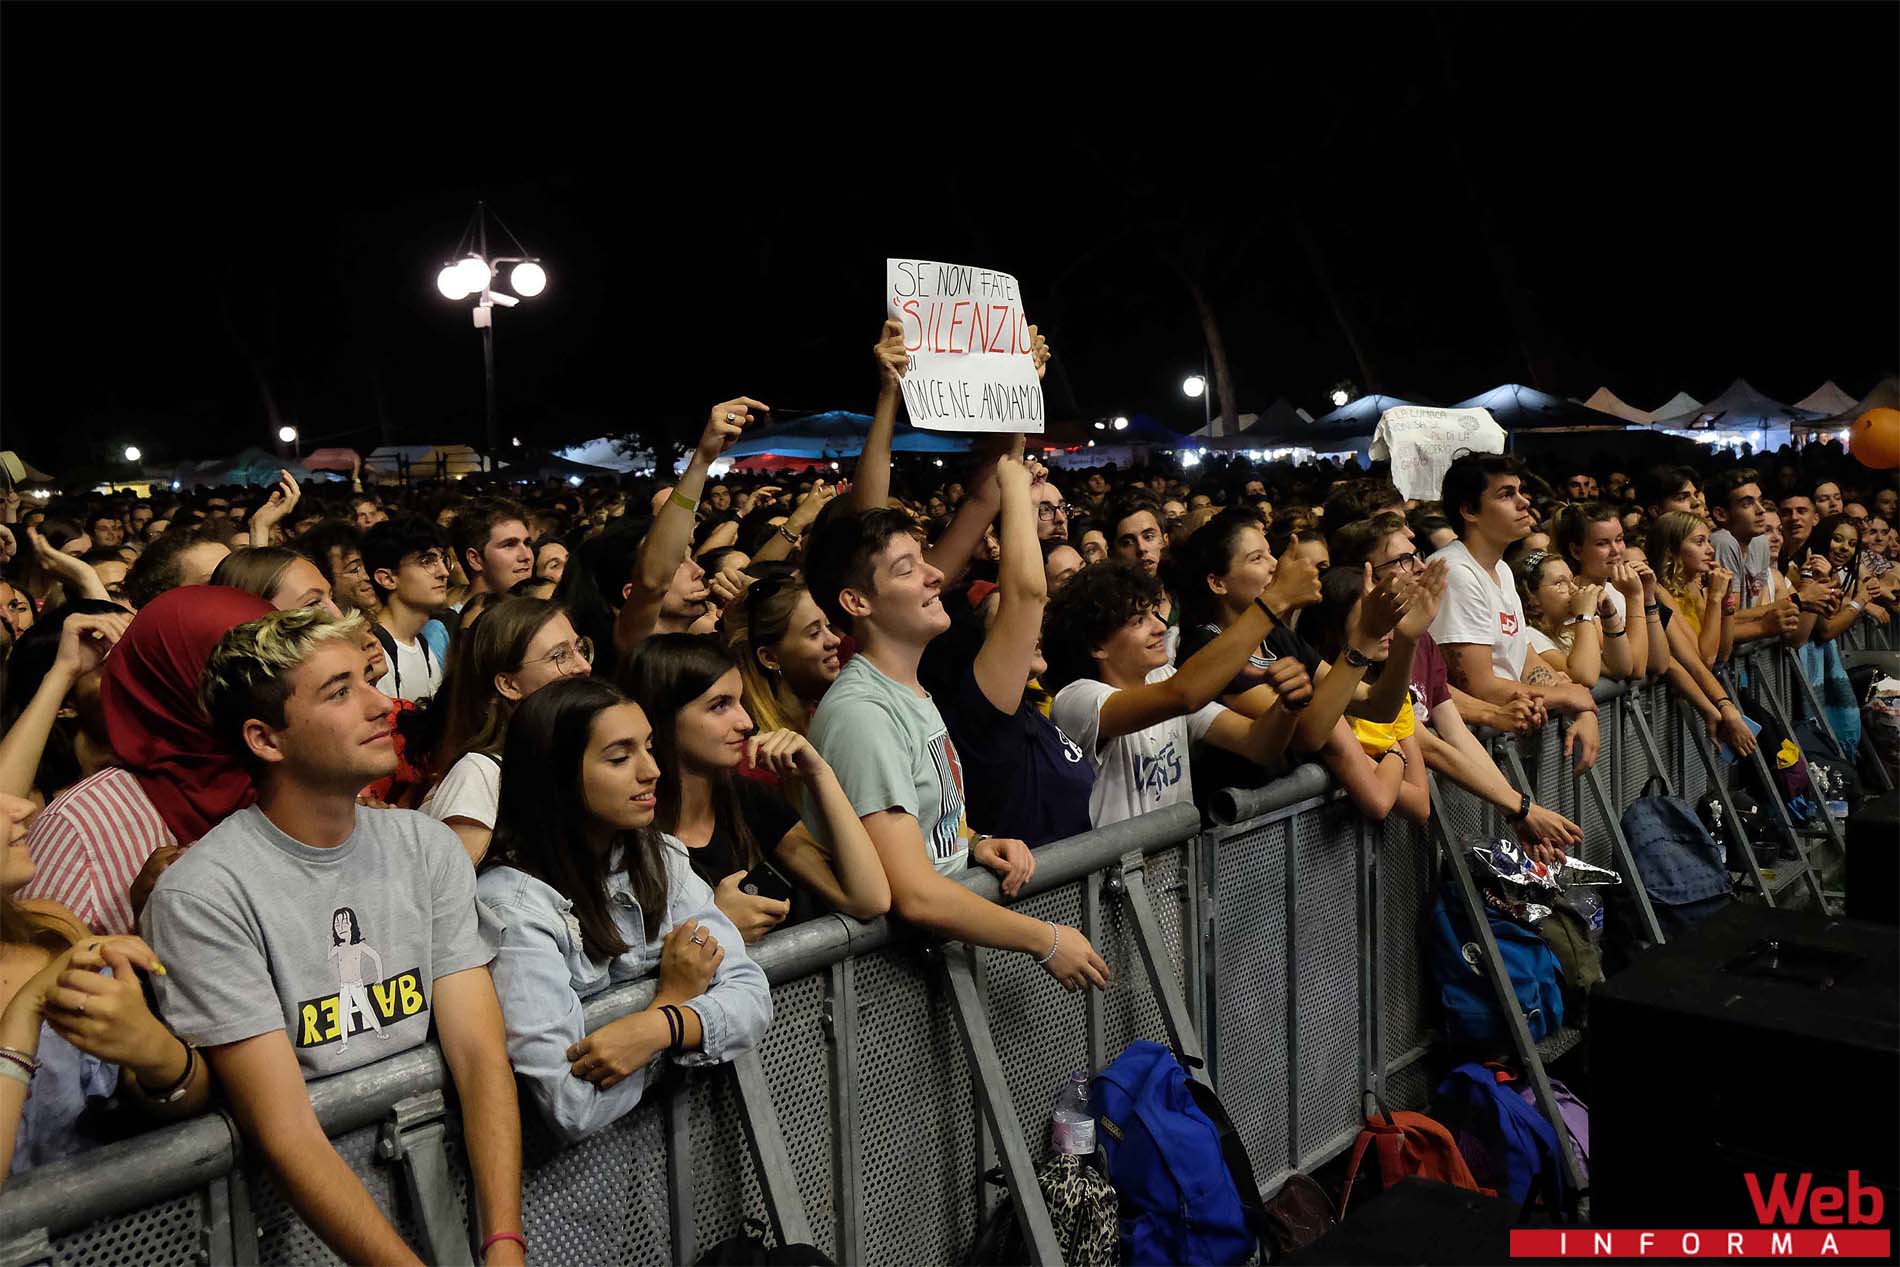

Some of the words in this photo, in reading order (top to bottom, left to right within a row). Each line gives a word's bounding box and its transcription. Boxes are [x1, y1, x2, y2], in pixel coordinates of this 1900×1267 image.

[894, 262, 931, 297] SE
[937, 266, 972, 296] NON
[980, 271, 1014, 300] FATE
[905, 354, 917, 371] OI
[930, 379, 949, 418] CE
[949, 379, 975, 419] NE
[980, 381, 1042, 427] ANDIAMO!
